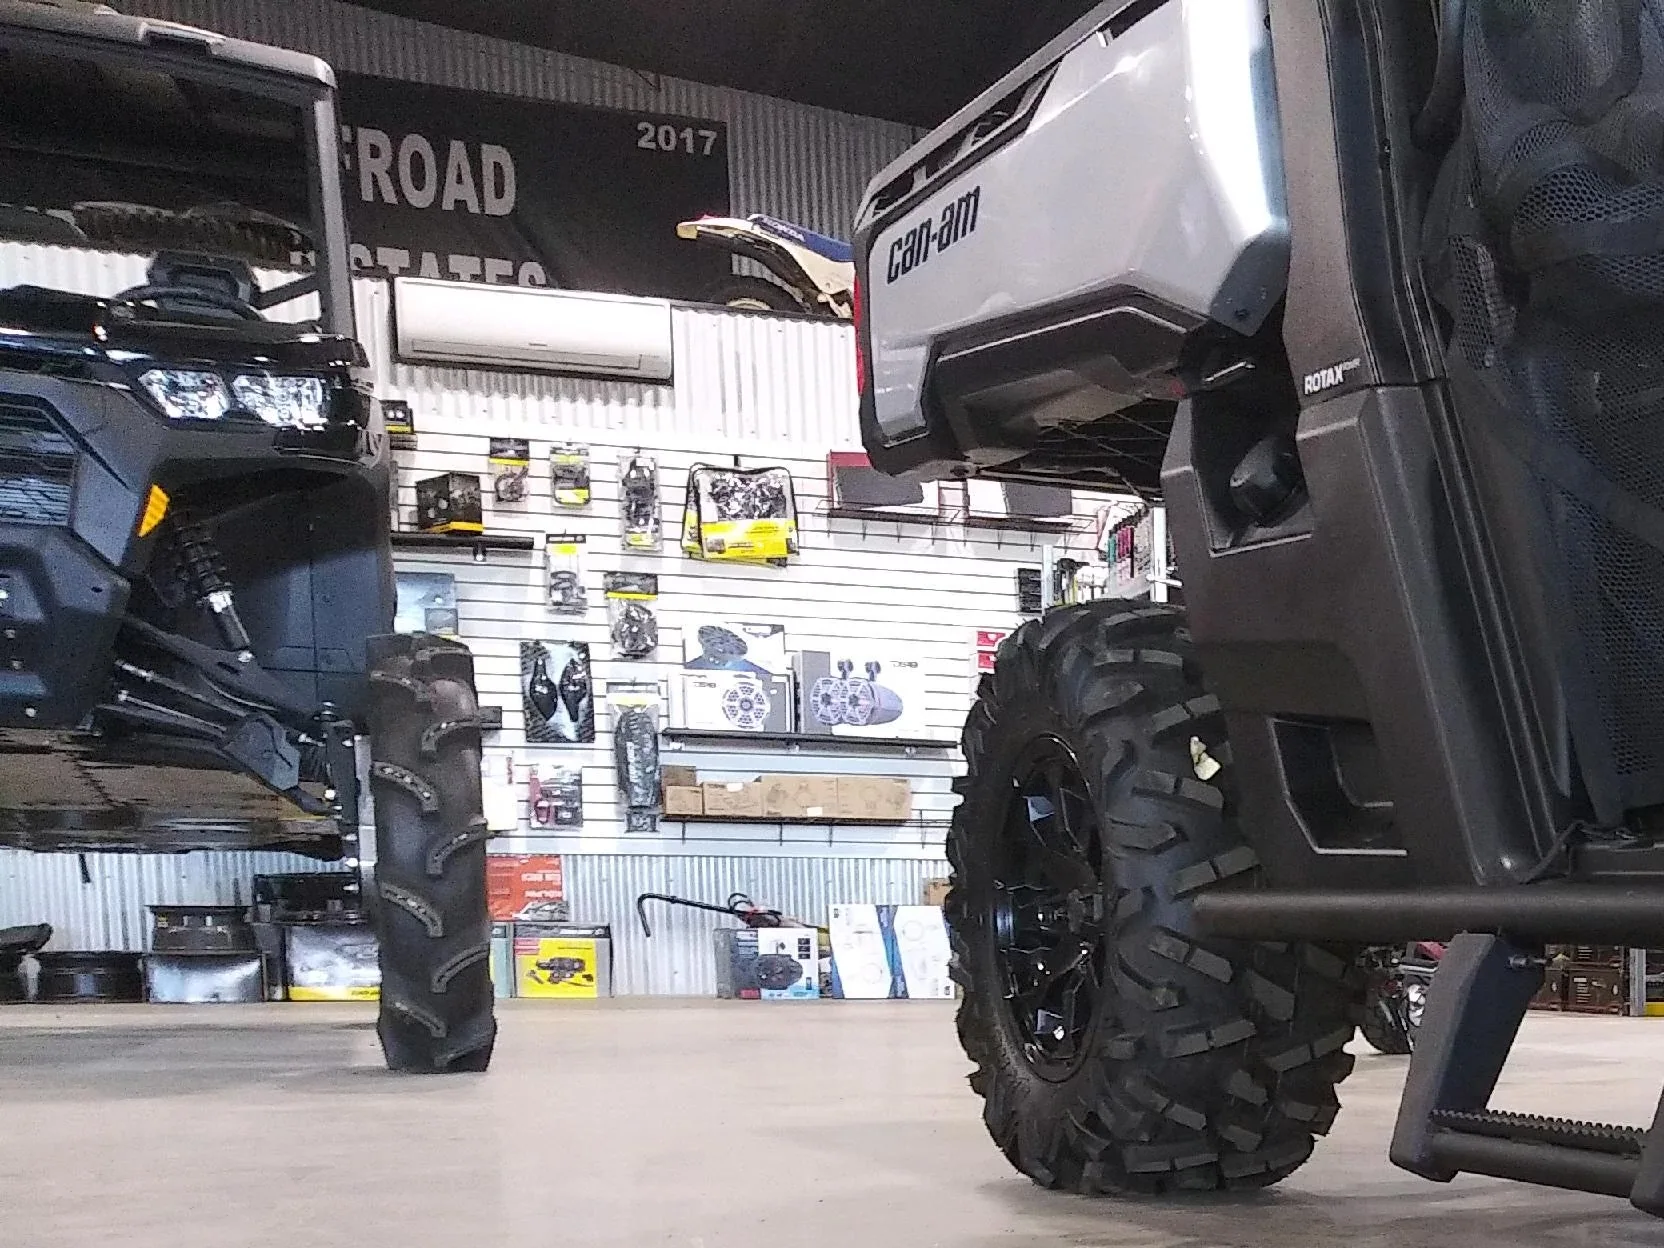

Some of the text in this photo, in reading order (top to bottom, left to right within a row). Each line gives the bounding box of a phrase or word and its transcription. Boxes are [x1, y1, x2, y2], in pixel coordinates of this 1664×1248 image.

[637, 122, 718, 155] 2017
[887, 186, 980, 284] can-am
[1304, 364, 1344, 395] ROTAX
